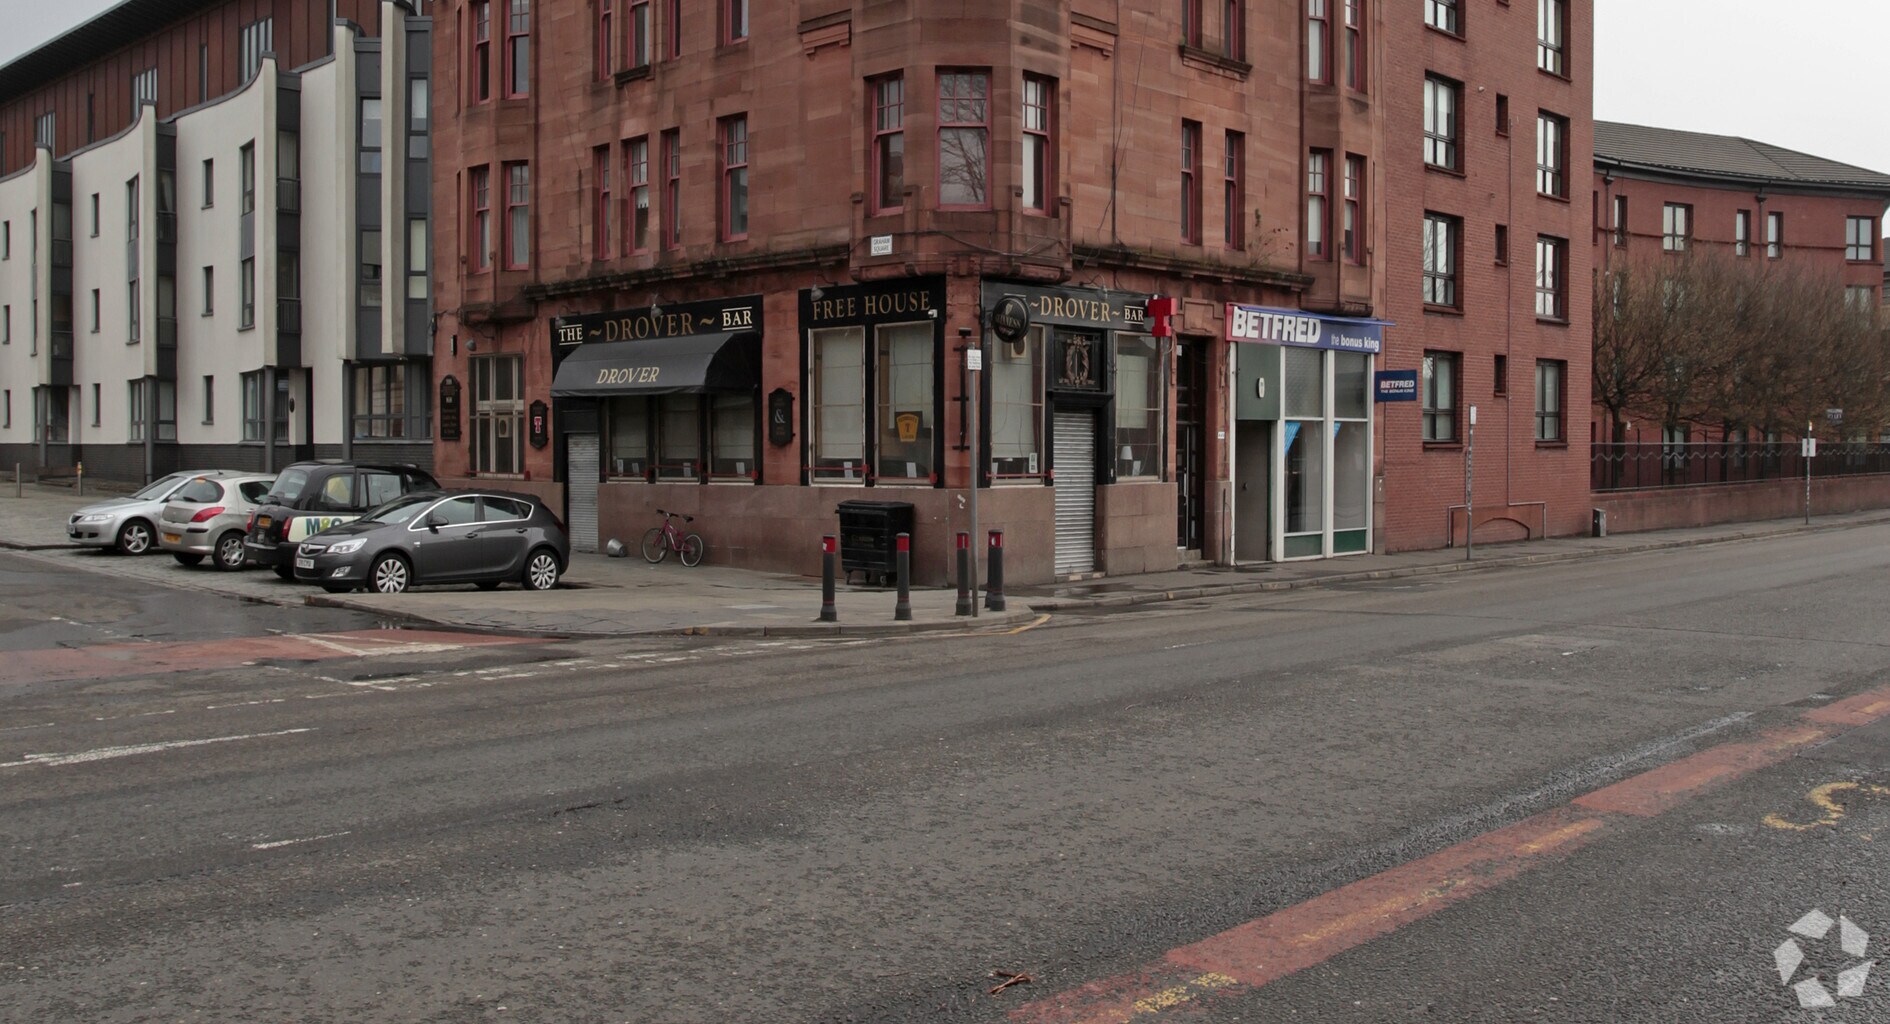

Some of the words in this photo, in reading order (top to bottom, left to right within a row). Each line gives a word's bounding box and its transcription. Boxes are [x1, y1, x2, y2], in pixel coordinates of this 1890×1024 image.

[812, 297, 856, 320] FREE
[864, 290, 932, 316] HOUSE
[1040, 295, 1111, 322] DROVER
[1124, 308, 1144, 321] BAR
[558, 327, 583, 342] THE
[604, 312, 694, 342] DROVER
[722, 310, 753, 326] BAR
[1231, 306, 1321, 344] BETFRED
[1340, 334, 1363, 348] bonus
[1364, 336, 1380, 352] king
[596, 367, 660, 385] DROVER
[1380, 380, 1415, 389] BETFRED
